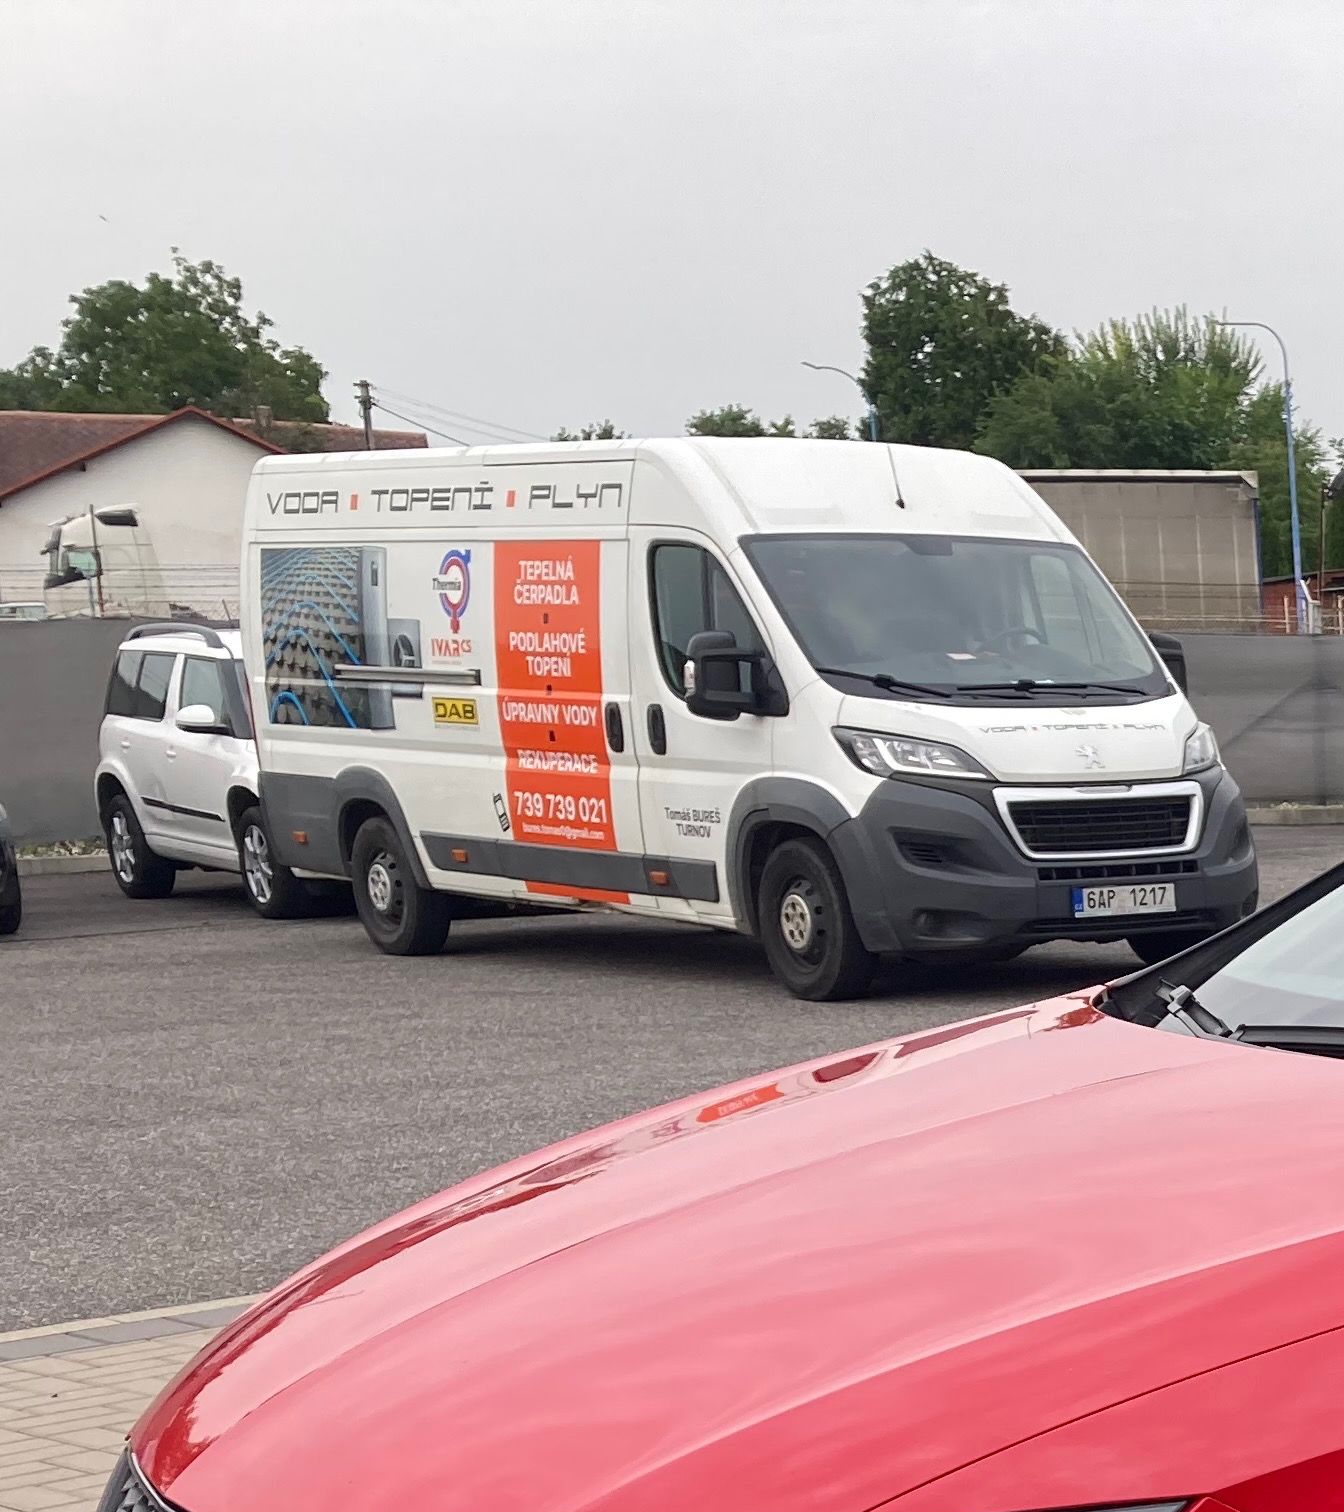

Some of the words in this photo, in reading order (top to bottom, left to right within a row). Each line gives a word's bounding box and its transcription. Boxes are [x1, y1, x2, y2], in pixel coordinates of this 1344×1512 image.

[266, 490, 339, 515] VODA
[370, 480, 494, 512] TOPENÍ
[528, 482, 623, 510] PLYN
[518, 555, 575, 581] TEPELNÁ
[513, 578, 579, 605] ČERPADLA
[508, 627, 586, 654] PODLAHOVÉ
[525, 651, 572, 677] TOPENÍ
[435, 702, 475, 720] DAB
[502, 696, 559, 724] ÚPRAVNY
[562, 703, 598, 727] VODY
[516, 749, 599, 774] REKUPERACE
[513, 790, 544, 818] 739
[545, 793, 576, 821] 739
[578, 796, 608, 824] 021
[692, 806, 720, 823] BUREŠ
[676, 823, 711, 838] TURNOV
[1087, 889, 1116, 909] 6AP
[1129, 886, 1167, 907] 1217
